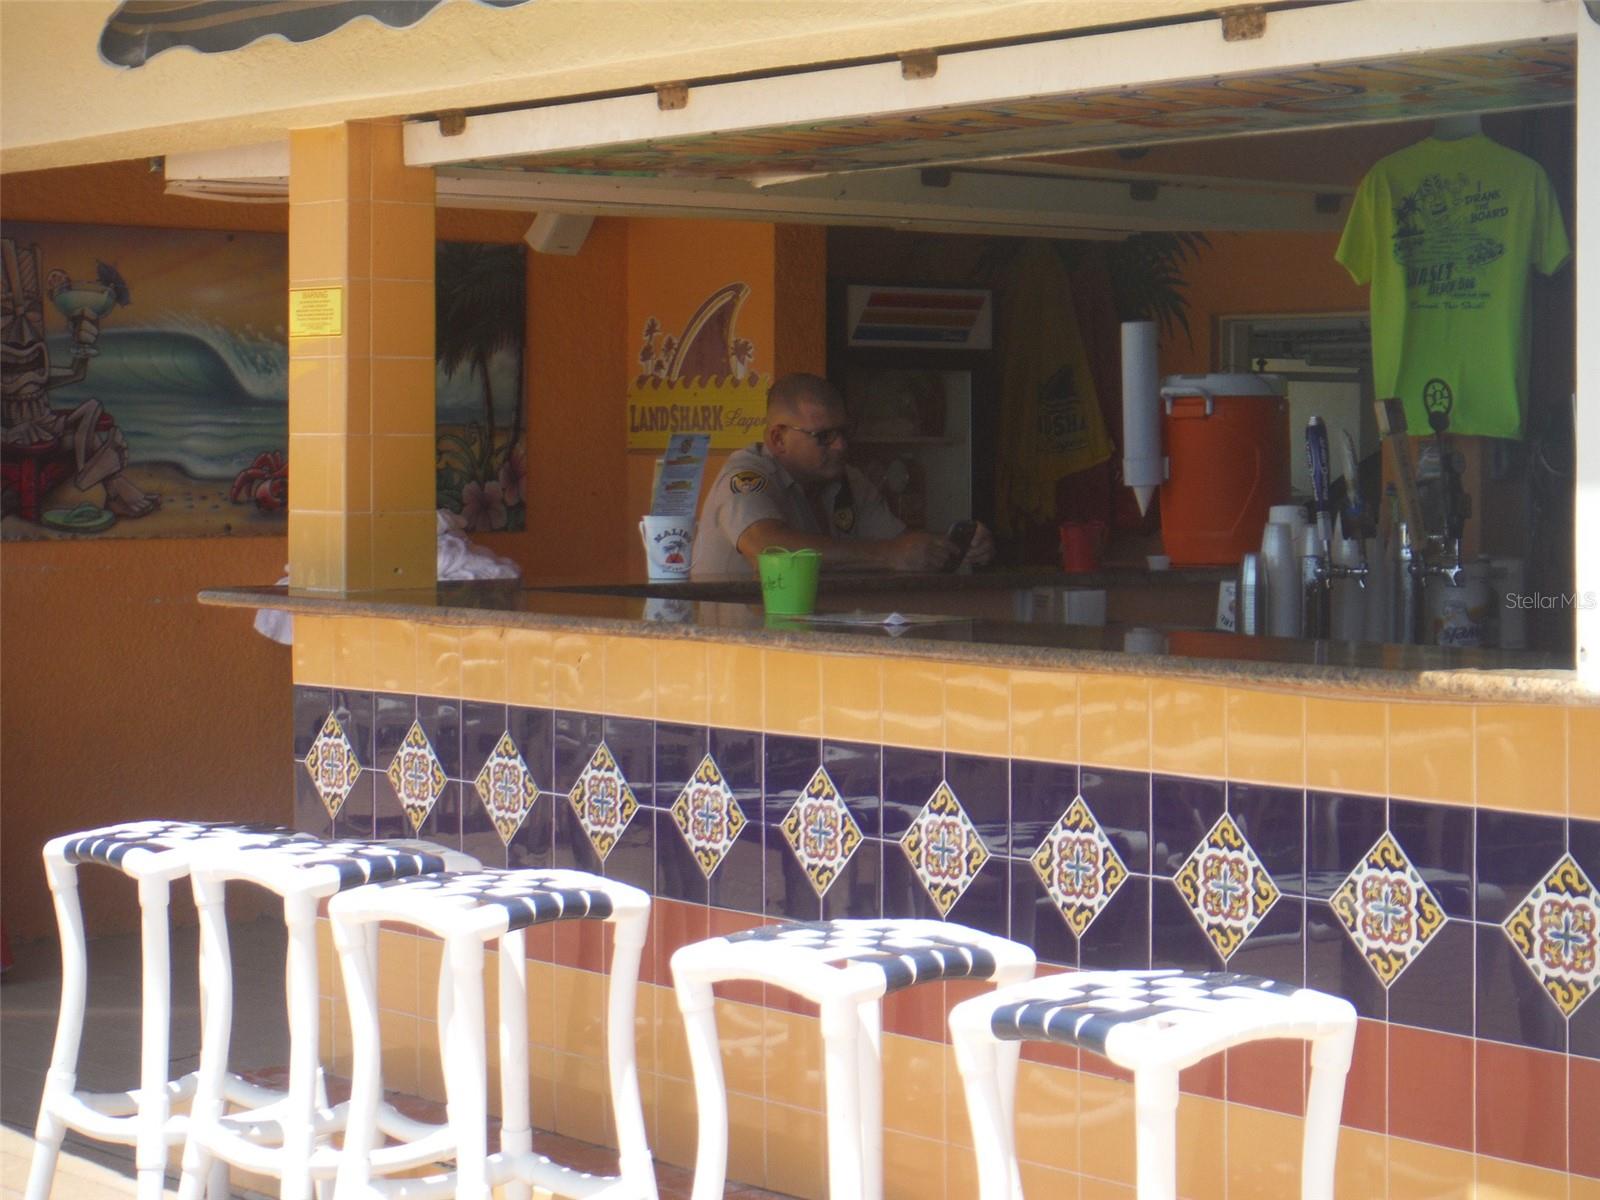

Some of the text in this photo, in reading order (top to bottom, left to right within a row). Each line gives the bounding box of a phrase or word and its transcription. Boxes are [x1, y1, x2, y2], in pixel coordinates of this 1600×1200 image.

[1465, 190, 1502, 205] DRANK
[1470, 207, 1509, 223] BOARD
[630, 404, 723, 433] LANDSHARK
